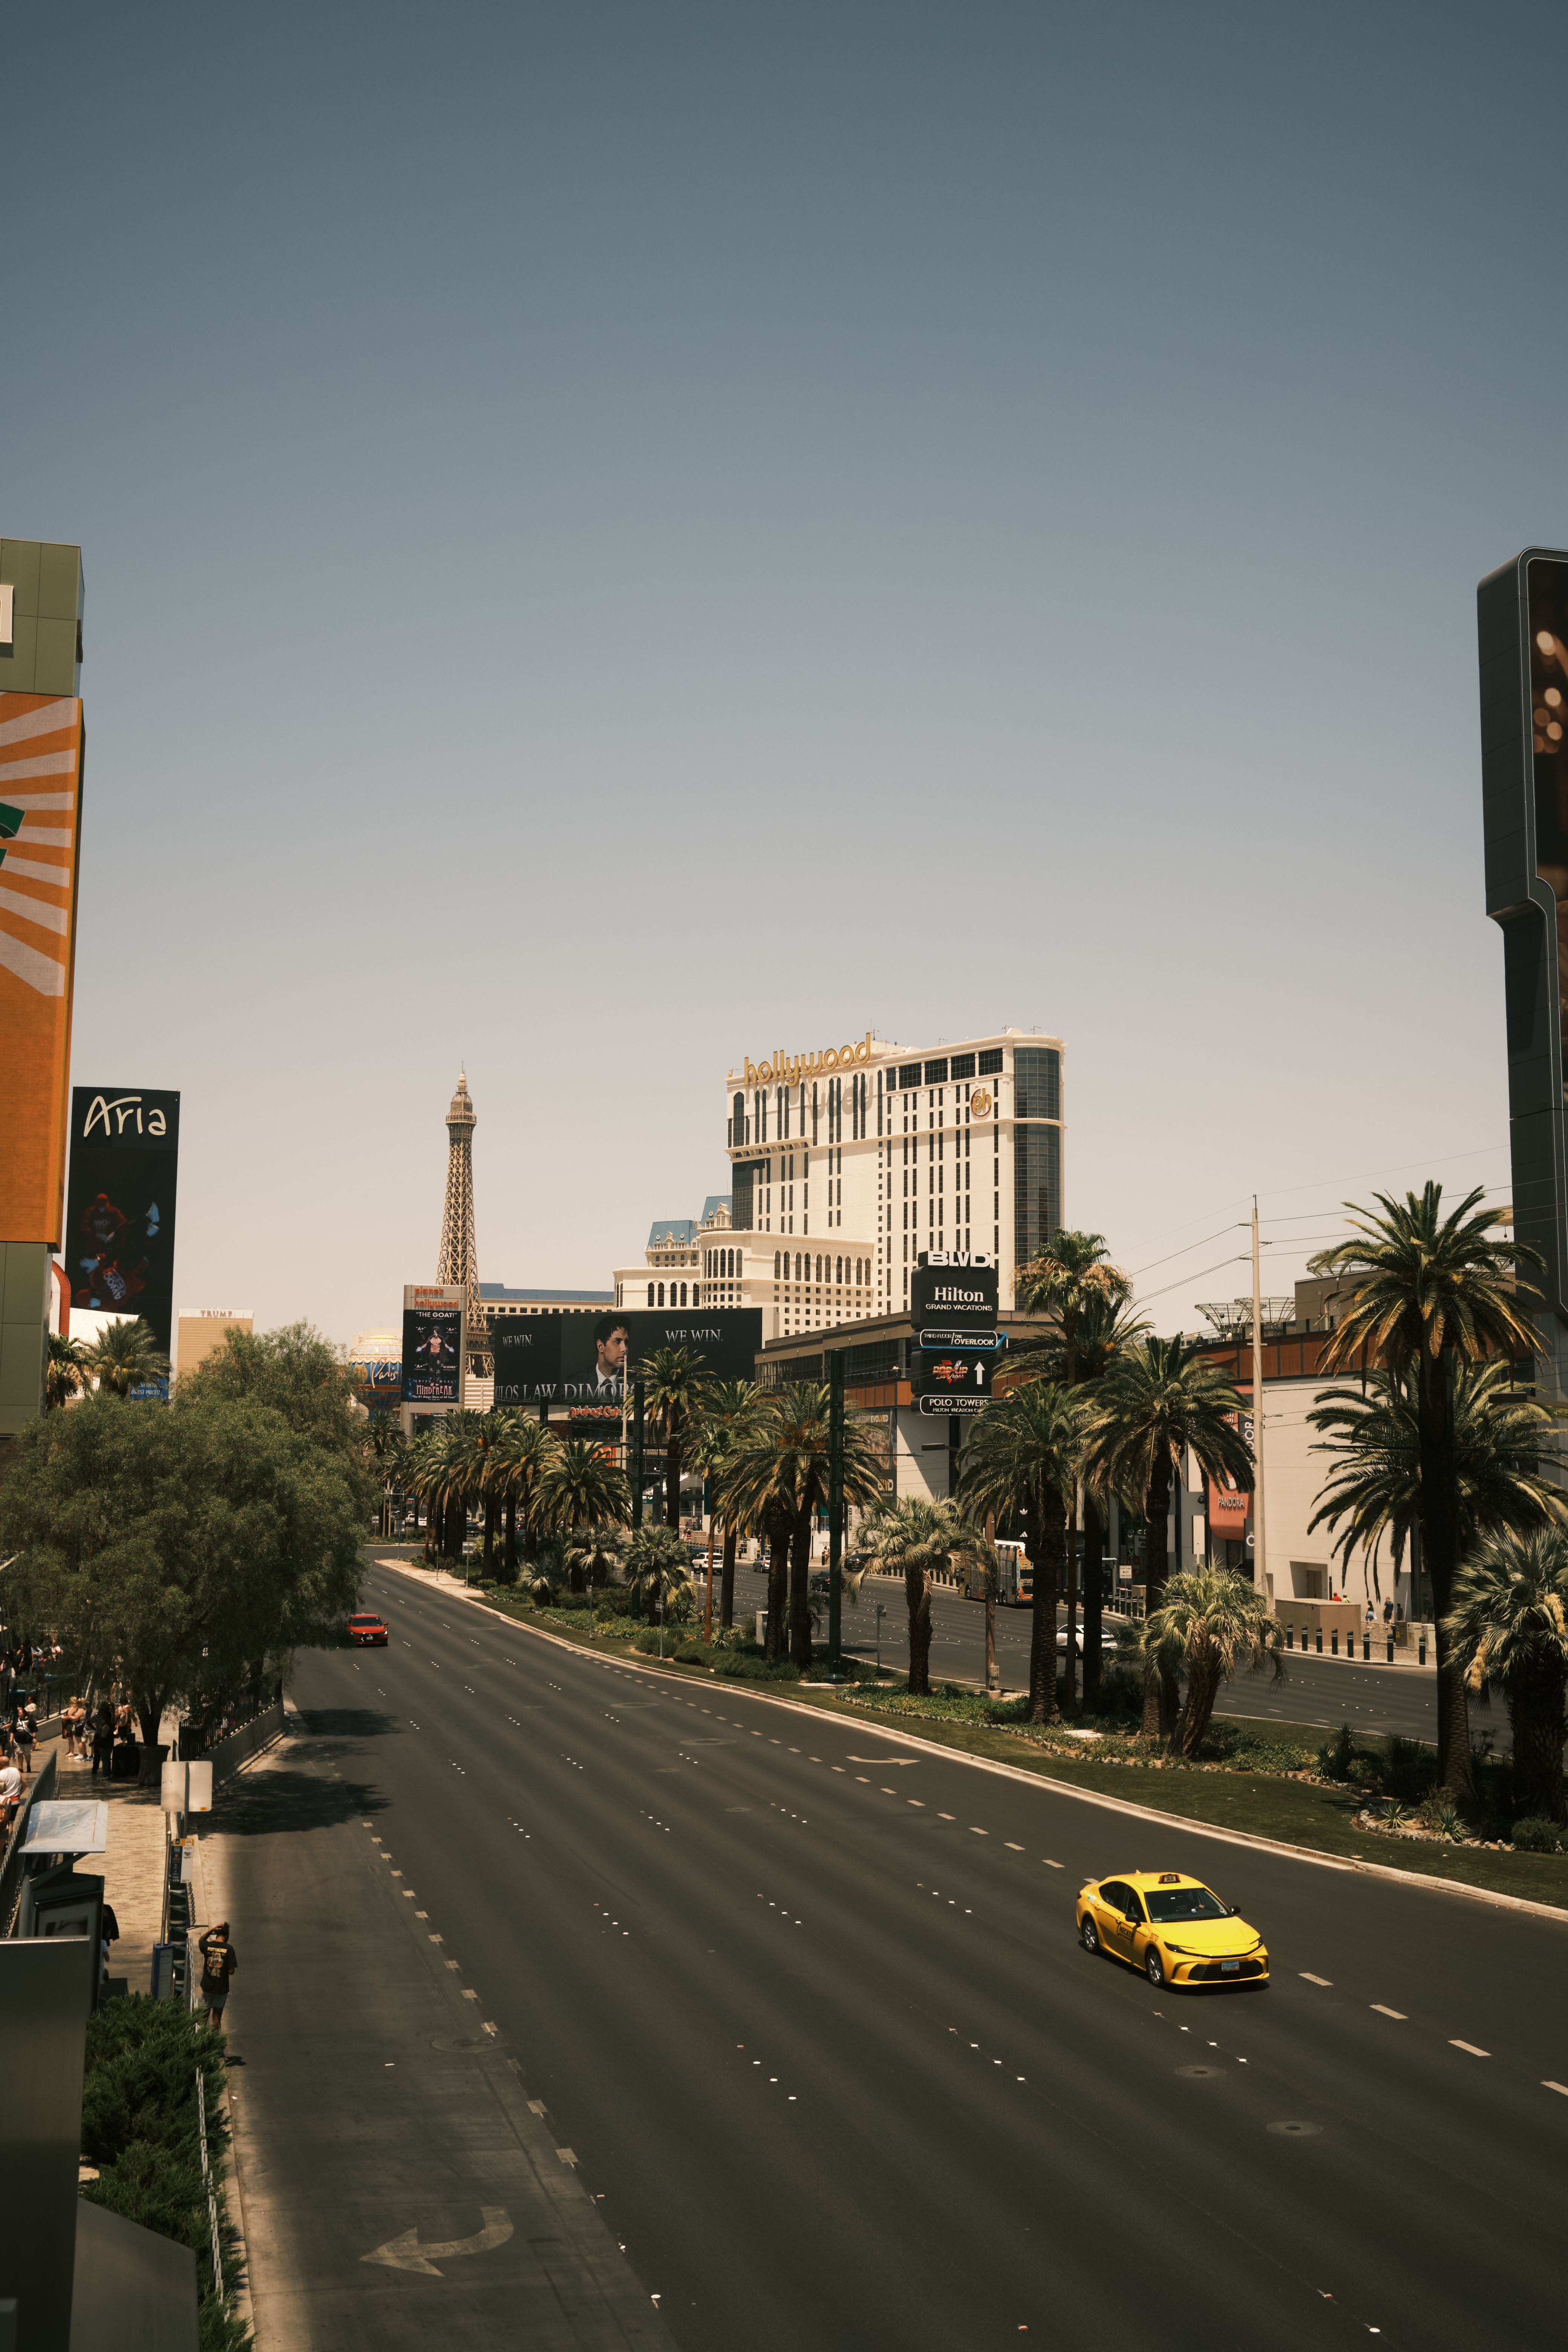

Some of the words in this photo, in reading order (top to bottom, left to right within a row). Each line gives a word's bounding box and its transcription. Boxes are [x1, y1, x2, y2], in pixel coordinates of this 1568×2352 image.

[744, 1032, 871, 1087] hollywood
[84, 1096, 167, 1137] Aria
[928, 1251, 990, 1267] BLVD
[414, 1286, 444, 1296] planet
[934, 1287, 984, 1302] Hilton
[414, 1298, 459, 1309] hollywood
[503, 1336, 513, 1348] WE
[514, 1335, 533, 1347] WIN.
[665, 1330, 688, 1343] WE
[691, 1329, 723, 1342] WIN.
[372, 1357, 398, 1389] Paris
[948, 1372, 965, 1382] Vegas
[416, 1385, 452, 1395] MINDFREAK
[523, 1384, 557, 1401] LAW
[870, 1414, 888, 1423] EVOLVED
[1150, 1932, 1159, 1942] 3570
